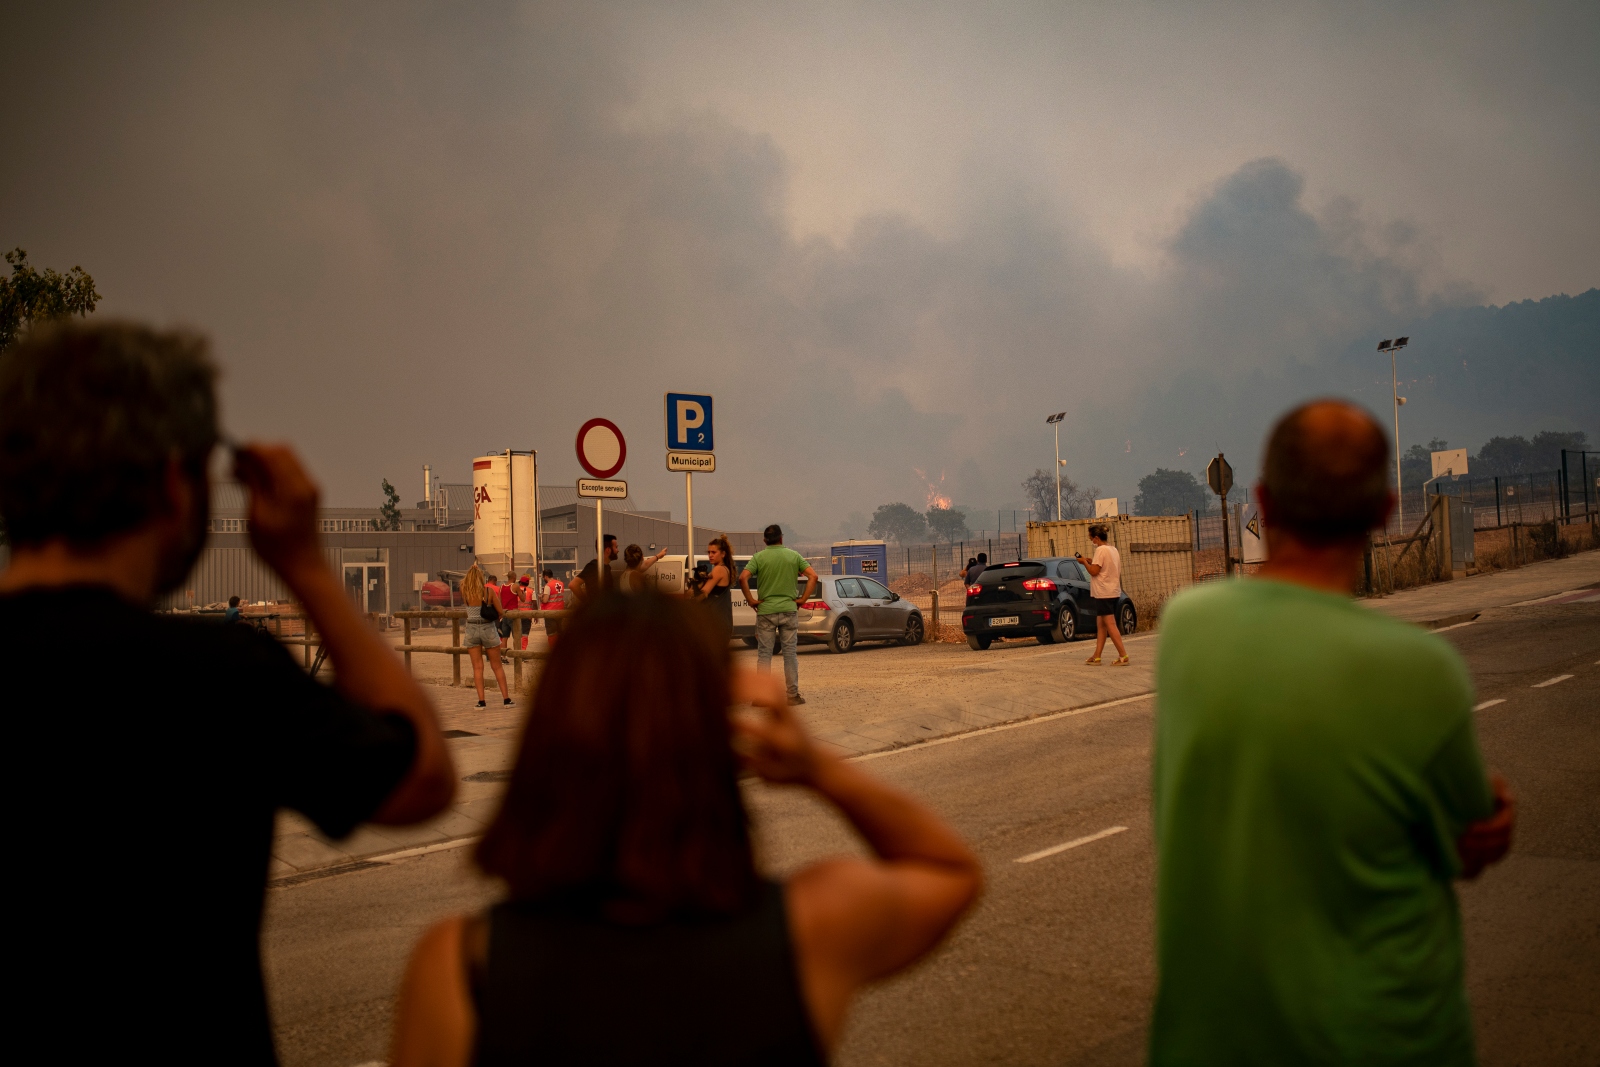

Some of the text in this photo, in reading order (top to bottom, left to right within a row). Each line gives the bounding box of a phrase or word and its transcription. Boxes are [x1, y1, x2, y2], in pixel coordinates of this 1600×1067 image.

[676, 399, 705, 444] P 2
[671, 456, 712, 467] Municipal
[581, 484, 603, 492] Excepte
[474, 503, 482, 520] X
[660, 572, 676, 582] Roja
